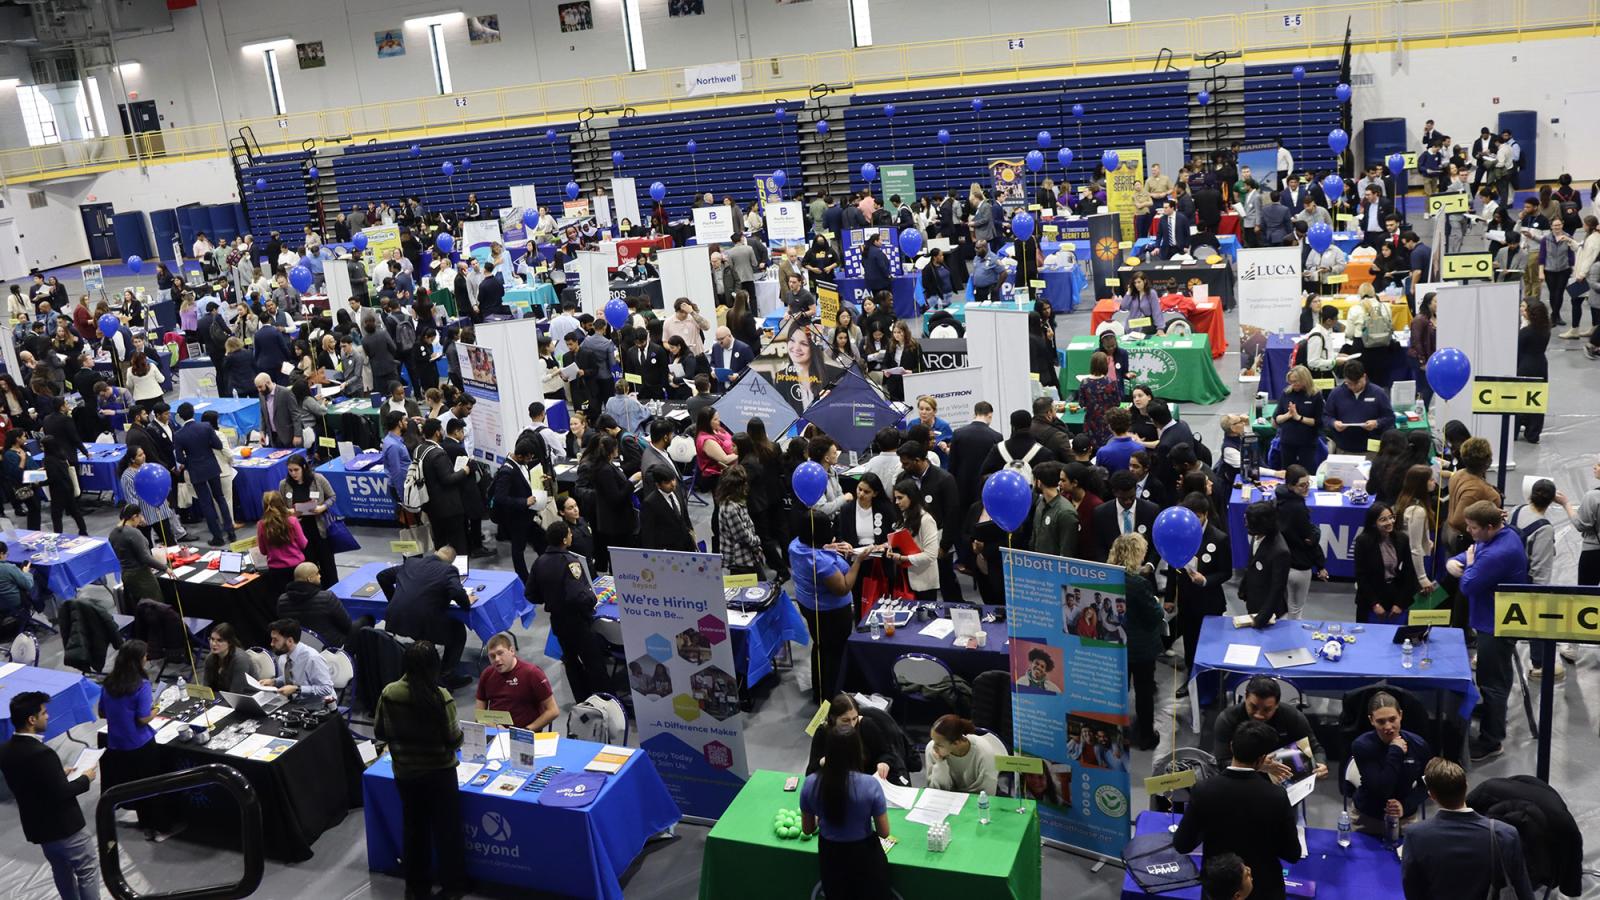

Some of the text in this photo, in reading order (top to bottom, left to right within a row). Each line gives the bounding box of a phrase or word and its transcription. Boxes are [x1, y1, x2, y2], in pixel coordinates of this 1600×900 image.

[1284, 15, 1302, 27] E-5
[1008, 38, 1024, 50] E-4
[696, 74, 737, 86] Northwell
[455, 97, 467, 107] E-2
[1407, 157, 1415, 165] Z
[1432, 201, 1441, 210] O
[1457, 198, 1465, 207] T
[1257, 265, 1296, 276] LUCA
[1449, 261, 1456, 272] L
[1476, 260, 1489, 272] O
[1479, 389, 1493, 405] C
[1526, 390, 1542, 406] K
[345, 475, 389, 497] FSW
[1003, 552, 1107, 580] Abbott House
[618, 573, 640, 583] ability
[621, 593, 708, 613] We're Hiring!
[624, 607, 642, 616] You
[644, 609, 661, 618] Can
[1502, 603, 1528, 625] A
[1577, 606, 1600, 630] C
[664, 721, 709, 734] Difference
[710, 727, 737, 738] Maker
[671, 751, 693, 763] Today
[465, 838, 520, 857] beyond
